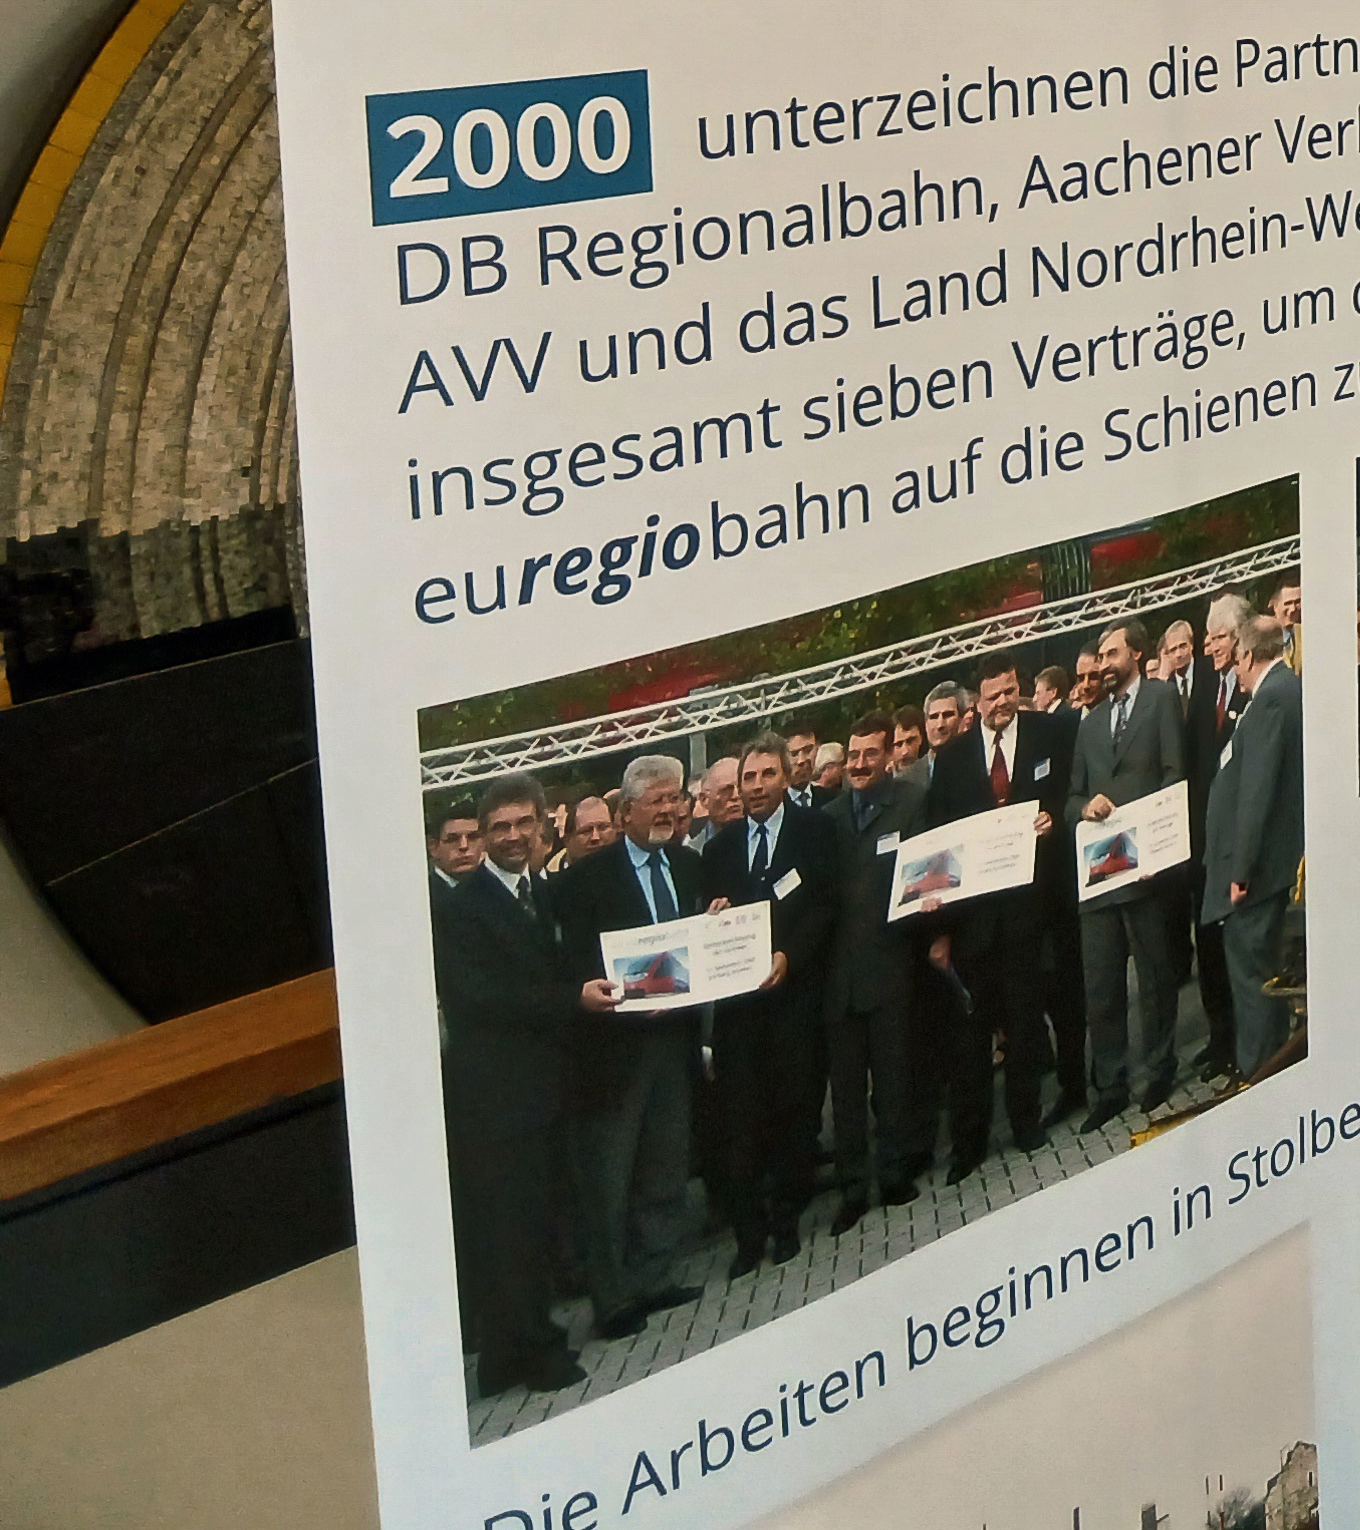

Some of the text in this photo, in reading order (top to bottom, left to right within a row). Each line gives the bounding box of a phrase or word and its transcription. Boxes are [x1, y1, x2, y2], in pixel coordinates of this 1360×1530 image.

[386, 95, 632, 199] 2000
[698, 66, 1129, 160] unterzeichnen
[1148, 46, 1218, 101] die
[397, 234, 508, 306] DB
[538, 170, 999, 289] Regionalbahn,
[1018, 139, 1262, 210] Aachener
[398, 331, 553, 414] AVV
[579, 301, 712, 382] und
[739, 290, 850, 354] das
[872, 249, 1009, 329] Land
[408, 398, 783, 520] insgesamt
[803, 357, 994, 441] sieben
[1011, 306, 1246, 390] Verträge,
[1262, 285, 1335, 335] um
[415, 481, 870, 625] euregiobahn
[891, 436, 984, 512] auf
[1001, 426, 1085, 487] die
[1103, 371, 1317, 462] Schienen
[484, 1490, 599, 1530] ie
[621, 1344, 888, 1516] Arbeiten
[907, 1213, 1155, 1370] beginnen
[1171, 1182, 1213, 1238] in
